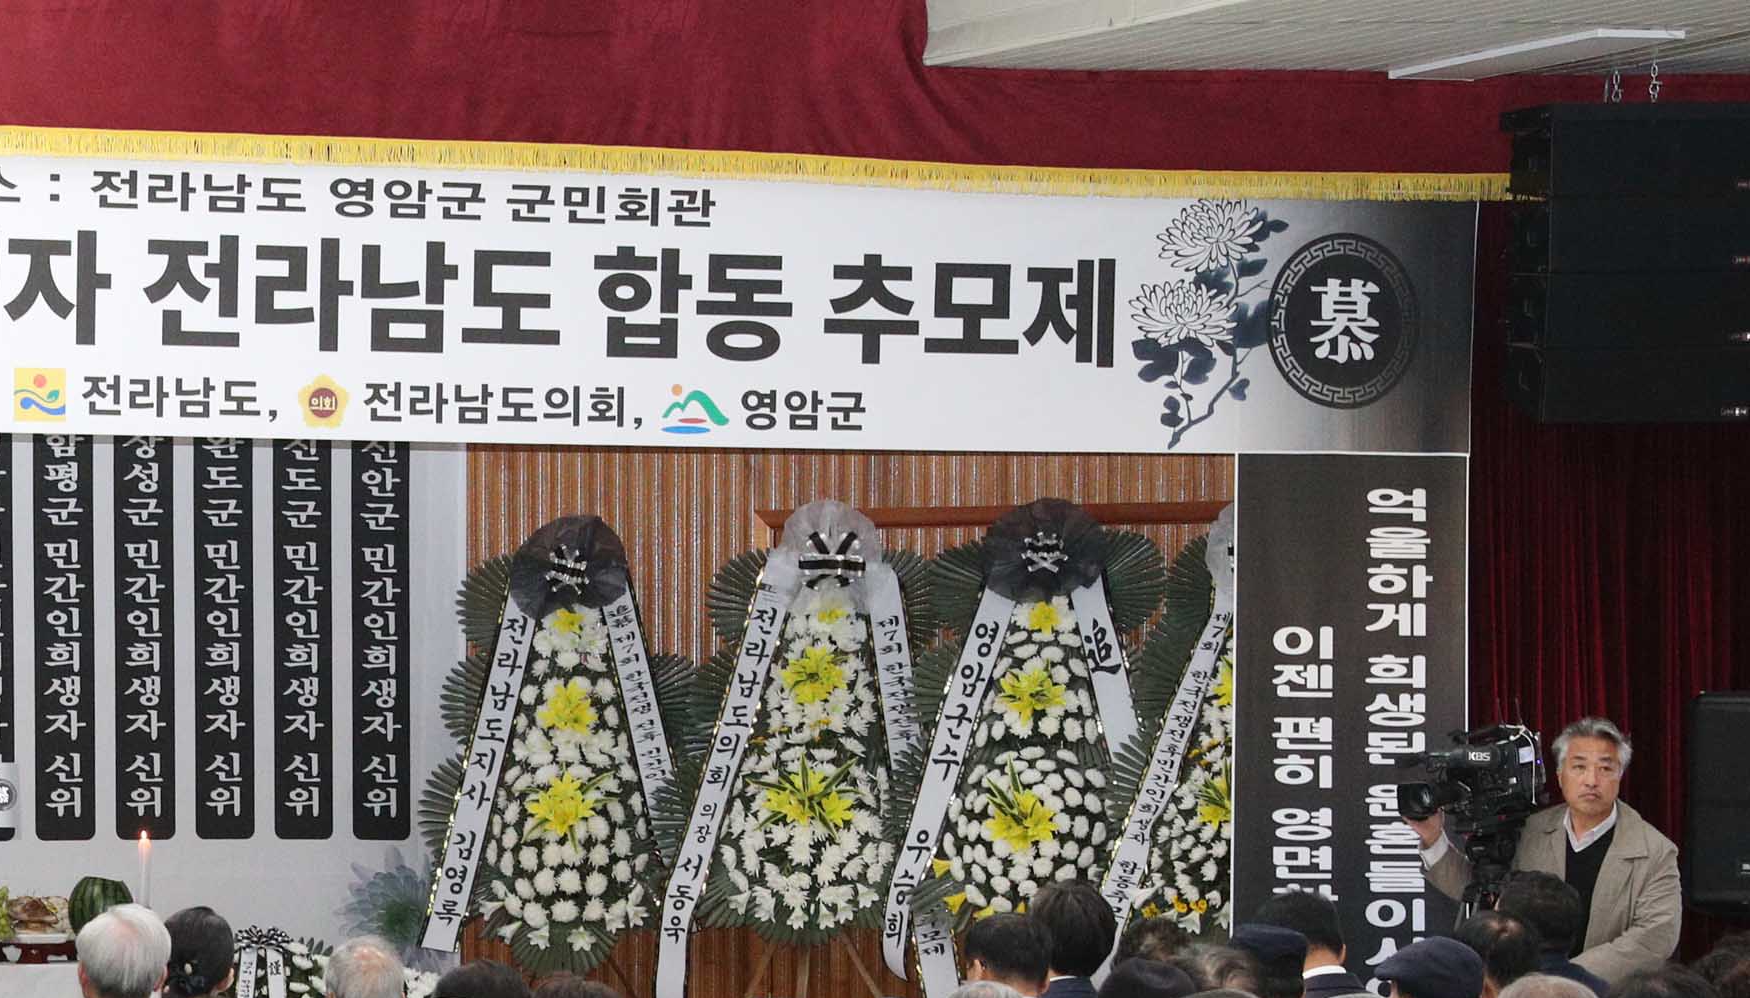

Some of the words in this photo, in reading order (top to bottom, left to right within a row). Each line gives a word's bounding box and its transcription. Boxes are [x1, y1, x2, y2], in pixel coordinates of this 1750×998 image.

[91, 167, 306, 213] 전라남도
[329, 177, 486, 221] 영암군
[506, 184, 716, 228] 군민회관
[143, 234, 561, 353] 전라남도
[593, 245, 793, 362] 합동
[823, 253, 1117, 368] 추모제
[1310, 278, 1380, 364] 慕
[82, 375, 278, 422] 전라남도,
[364, 381, 643, 430] 전라남도의회,
[741, 389, 866, 431] 영암군
[1364, 487, 1434, 639] 억울하게
[43, 538, 87, 741] 민간인희생자
[123, 539, 167, 741] 민간인희생자
[203, 539, 246, 740] 민간인희생자
[282, 541, 325, 741] 민간인희생자
[361, 543, 402, 742] 민간인희생자
[1271, 624, 1334, 699] 이젠
[460, 616, 531, 811] 전라남도지사
[705, 607, 778, 792] 전라남도의회
[932, 619, 1001, 782] 영암군수
[1364, 654, 1427, 766] 희생된
[45, 752, 84, 818] 신위
[125, 752, 164, 818] 신위
[205, 751, 243, 817] 신위
[284, 752, 321, 817] 신위
[362, 753, 399, 818] 신위
[1271, 716, 1334, 790] 편히
[1467, 751, 1491, 762] KBS
[694, 802, 719, 843] 의장
[1271, 806, 1339, 902] 영면
[434, 832, 478, 924] 김영록
[661, 856, 704, 944] 서동욱
[885, 829, 931, 950] 우승희
